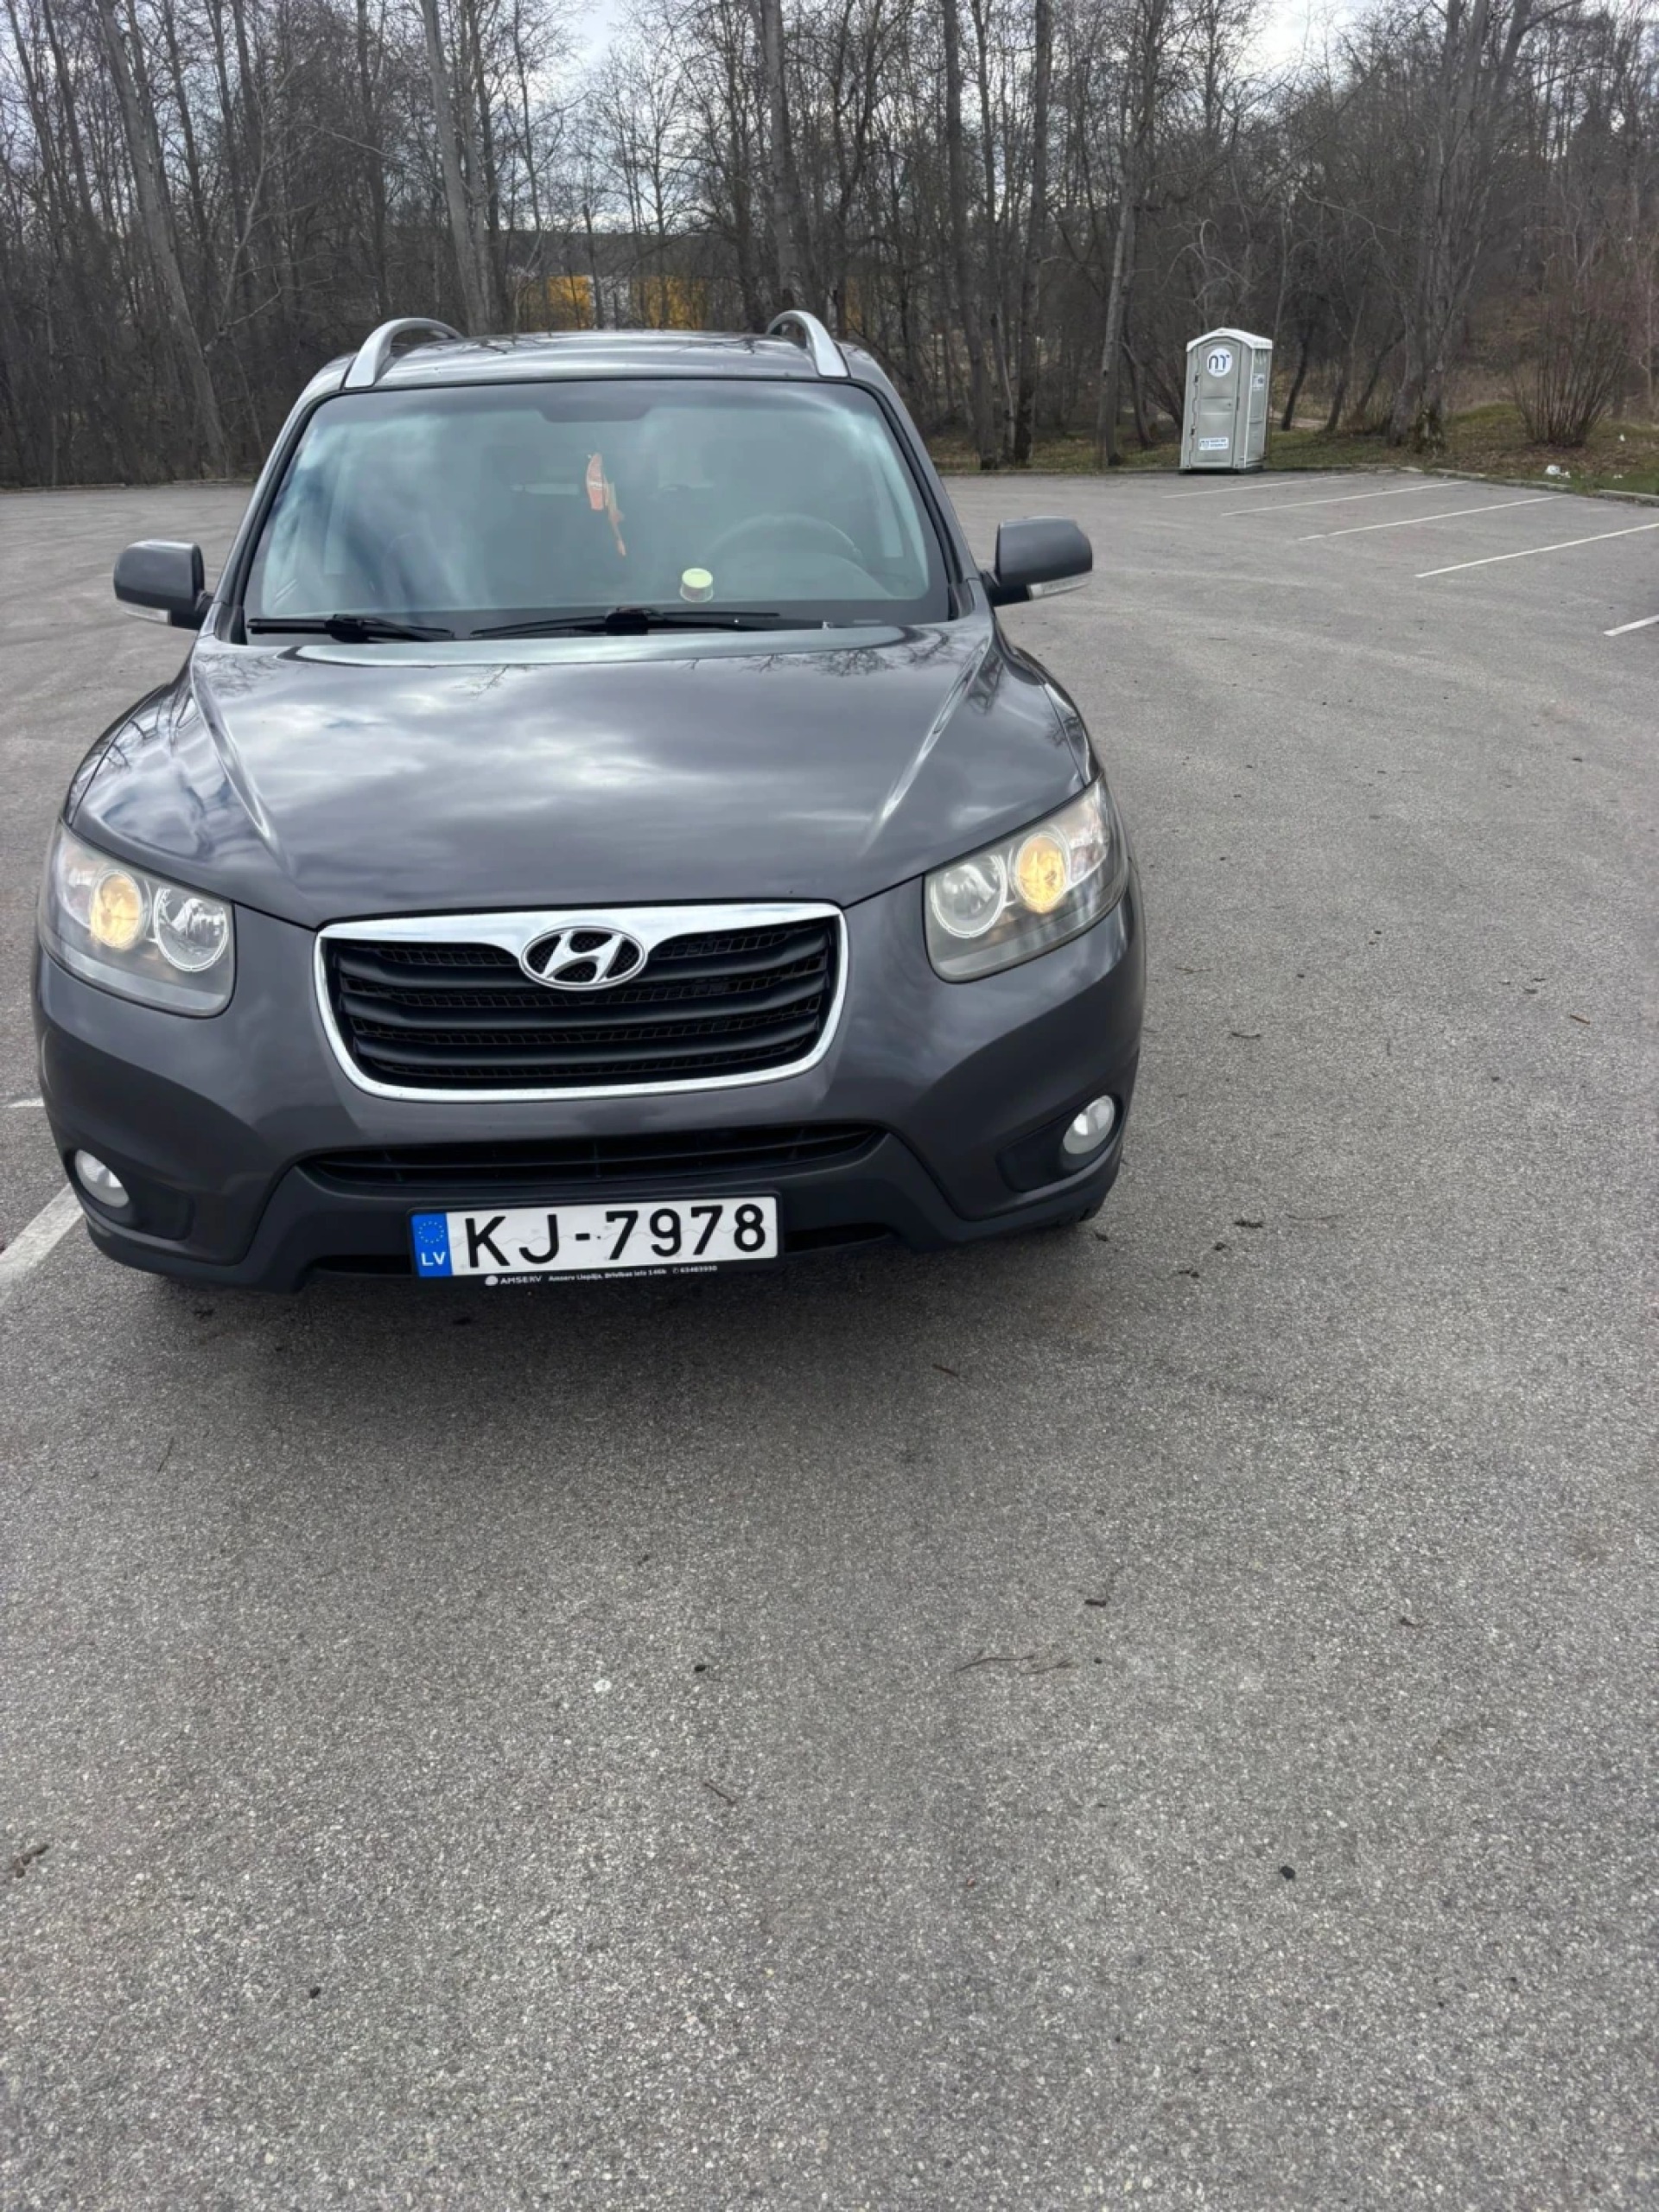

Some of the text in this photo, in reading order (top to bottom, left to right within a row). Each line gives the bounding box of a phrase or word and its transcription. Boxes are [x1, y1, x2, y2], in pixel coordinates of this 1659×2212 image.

[421, 1204, 766, 1268] LV KJ-7978
[500, 1275, 543, 1285] AMSERV
